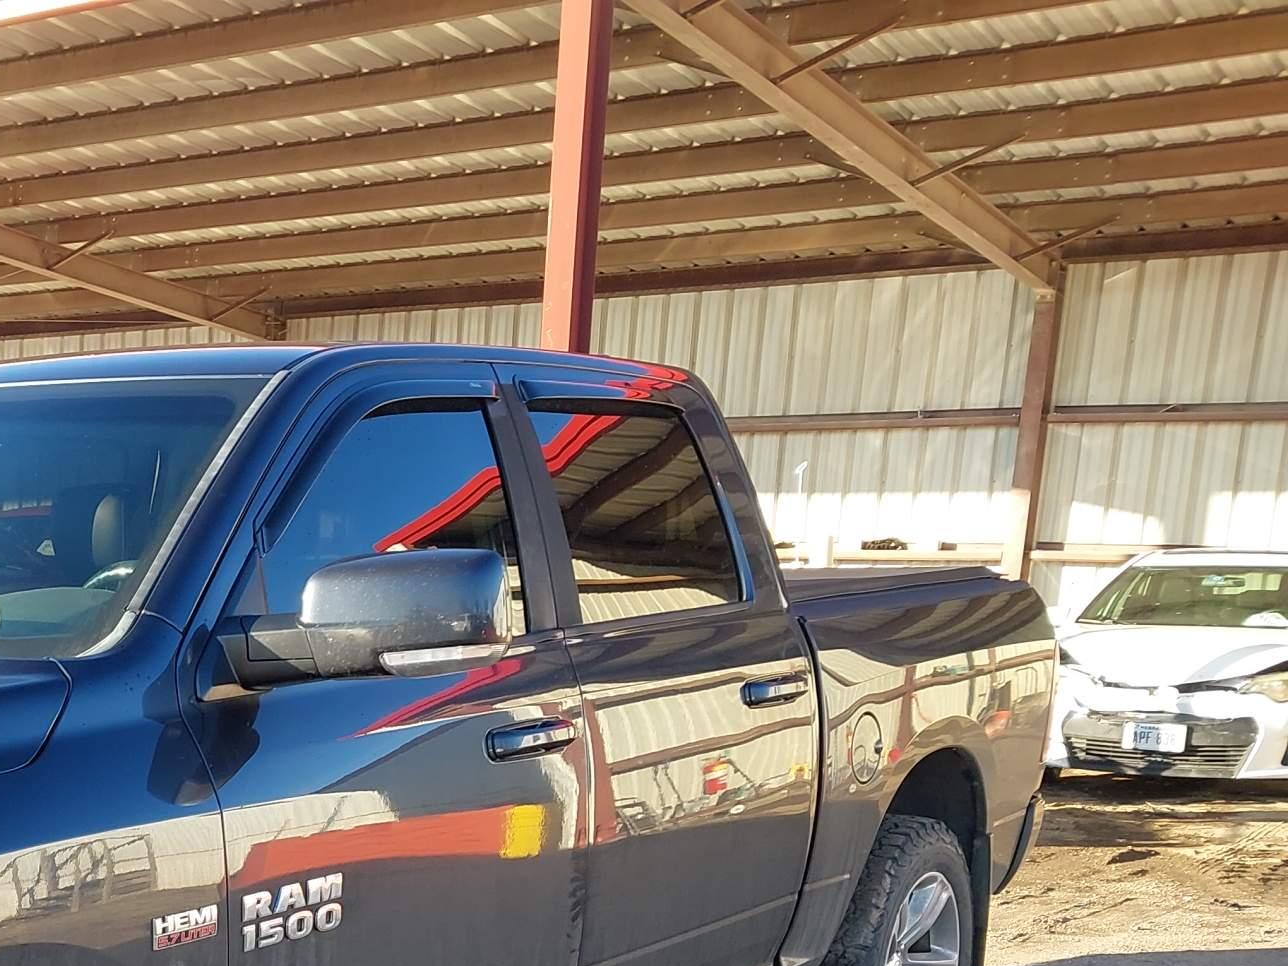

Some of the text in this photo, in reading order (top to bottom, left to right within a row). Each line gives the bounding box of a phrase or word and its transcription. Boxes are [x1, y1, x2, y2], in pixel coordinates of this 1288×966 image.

[242, 872, 343, 922] RAM
[153, 904, 218, 935] HEMI
[158, 923, 216, 949] 5.7 LITER
[242, 902, 343, 953] 1500
